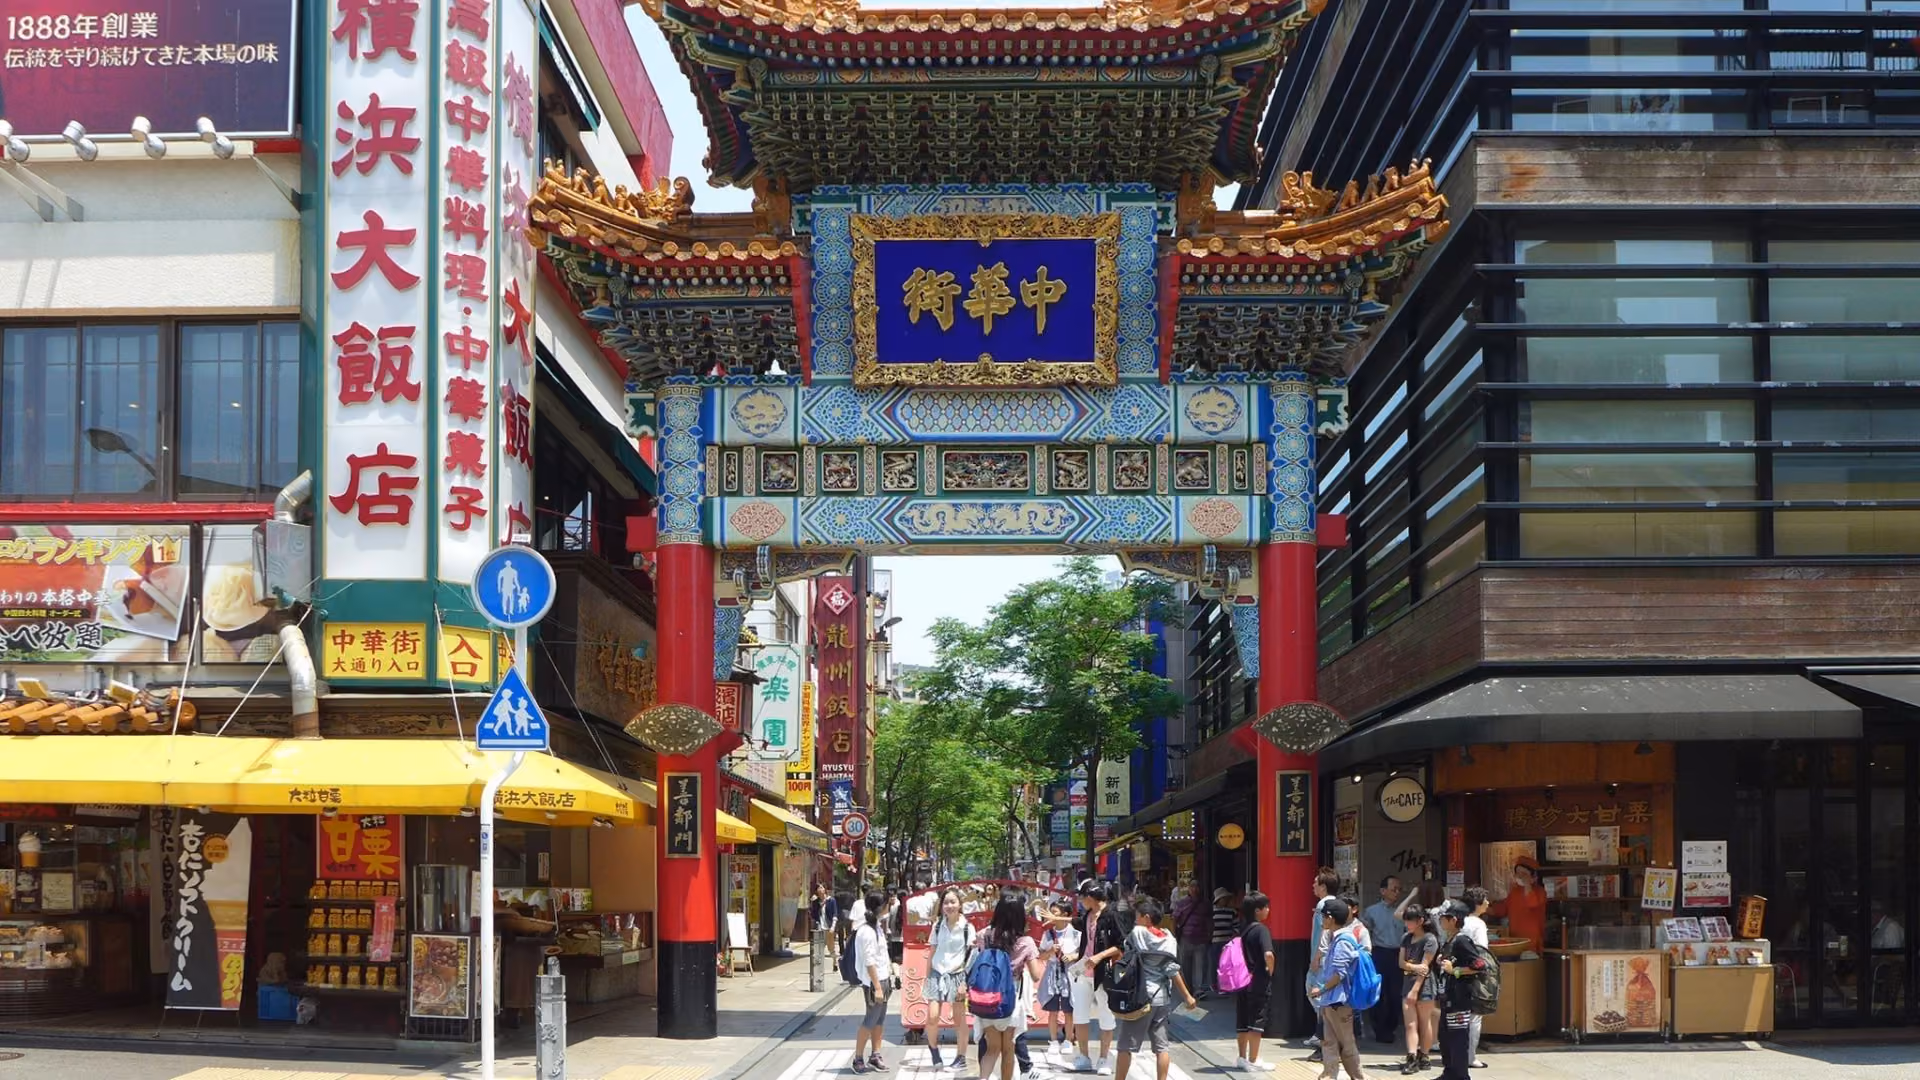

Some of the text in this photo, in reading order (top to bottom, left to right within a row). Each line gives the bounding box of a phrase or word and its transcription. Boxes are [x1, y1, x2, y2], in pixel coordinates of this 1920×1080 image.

[7, 12, 158, 41] 1888年創業
[4, 43, 279, 70] 伝統を守り続けてきた本場の味
[329, 0, 422, 526] 横浜大飯店
[830, 590, 846, 607] 福
[332, 628, 420, 655] 中華街
[449, 634, 483, 677] 入口
[332, 657, 420, 673] 大通り入口
[824, 623, 857, 753] 龍州飯店
[761, 675, 790, 746] 楽園
[822, 764, 855, 772] RYUSYU
[1399, 793, 1423, 807] CAFE
[848, 821, 862, 832] 30
[321, 812, 400, 879] 甘栗
[170, 819, 206, 991] 杏仁ソフトクリーム
